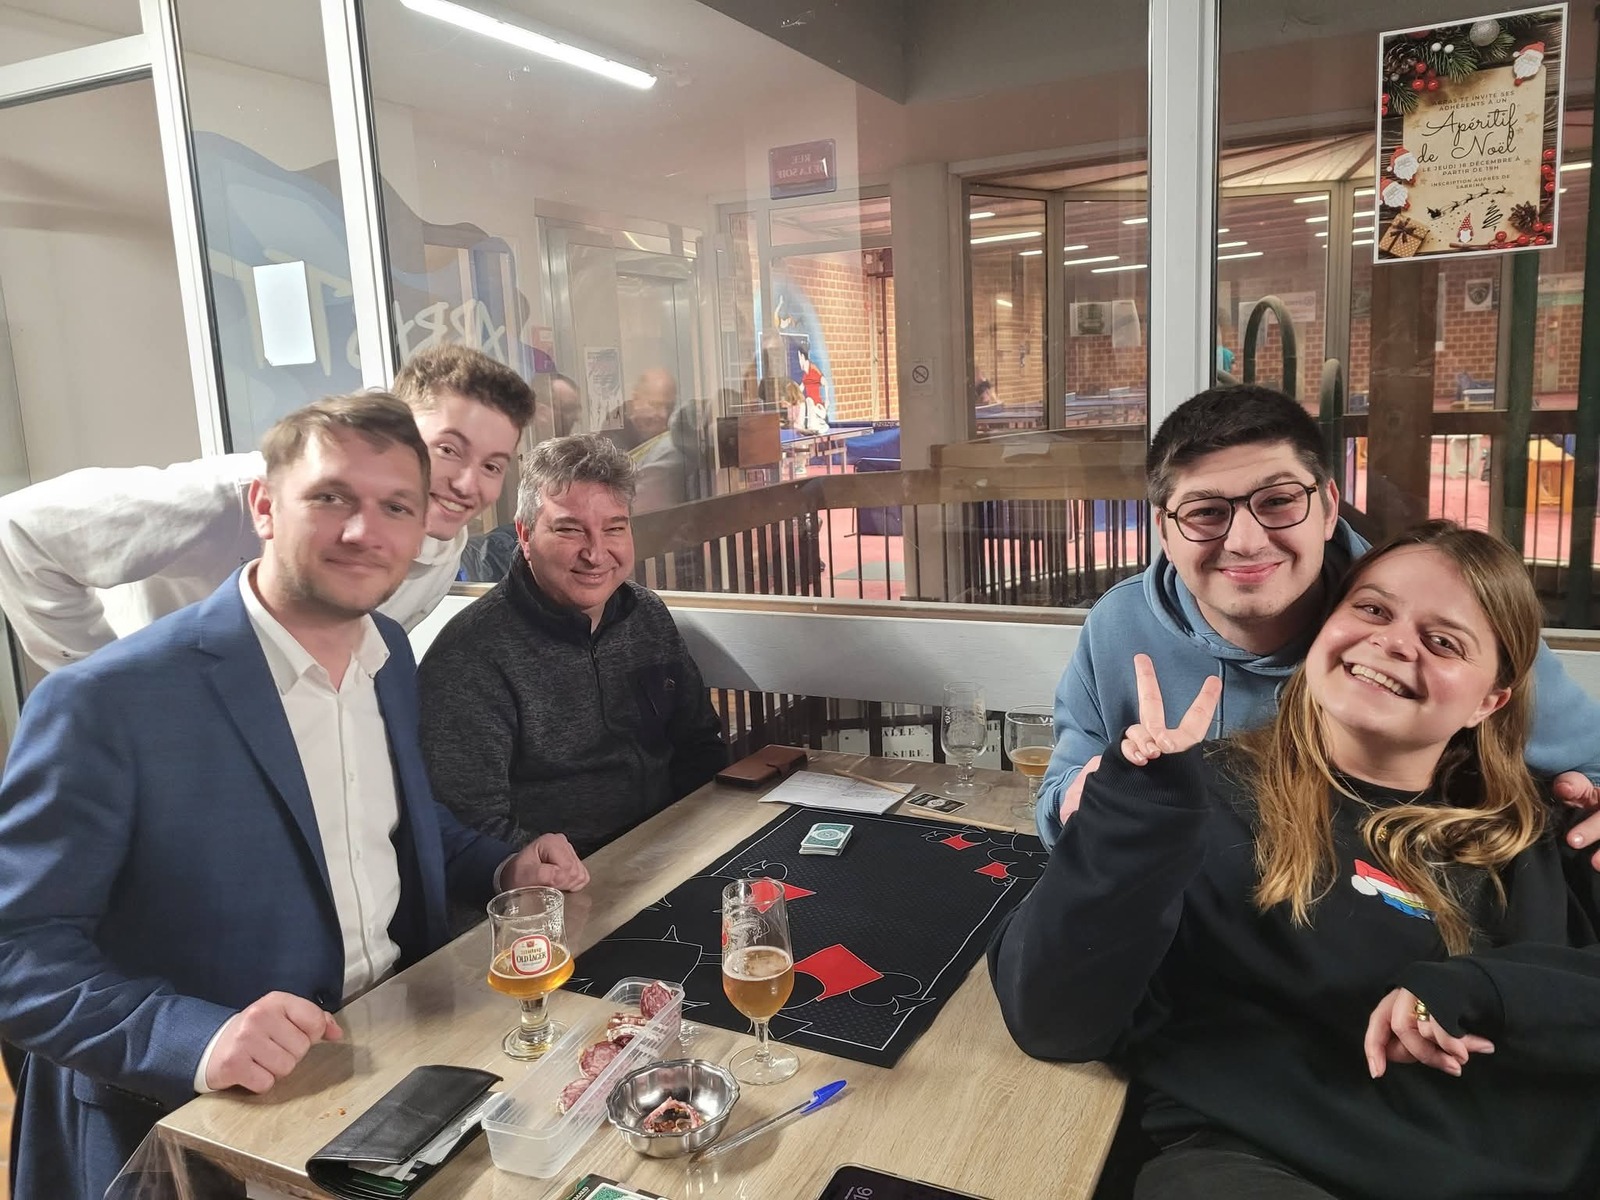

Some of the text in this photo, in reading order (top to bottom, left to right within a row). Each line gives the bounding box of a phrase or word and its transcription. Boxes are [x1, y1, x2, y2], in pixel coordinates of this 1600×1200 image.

[1471, 92, 1497, 101] INVITE
[1421, 103, 1518, 146] Apéritif
[1417, 127, 1517, 164] de Noël
[1434, 163, 1456, 171] JEUDI
[1442, 168, 1470, 176] PARTIR
[1431, 178, 1472, 188] INSCRIPTION
